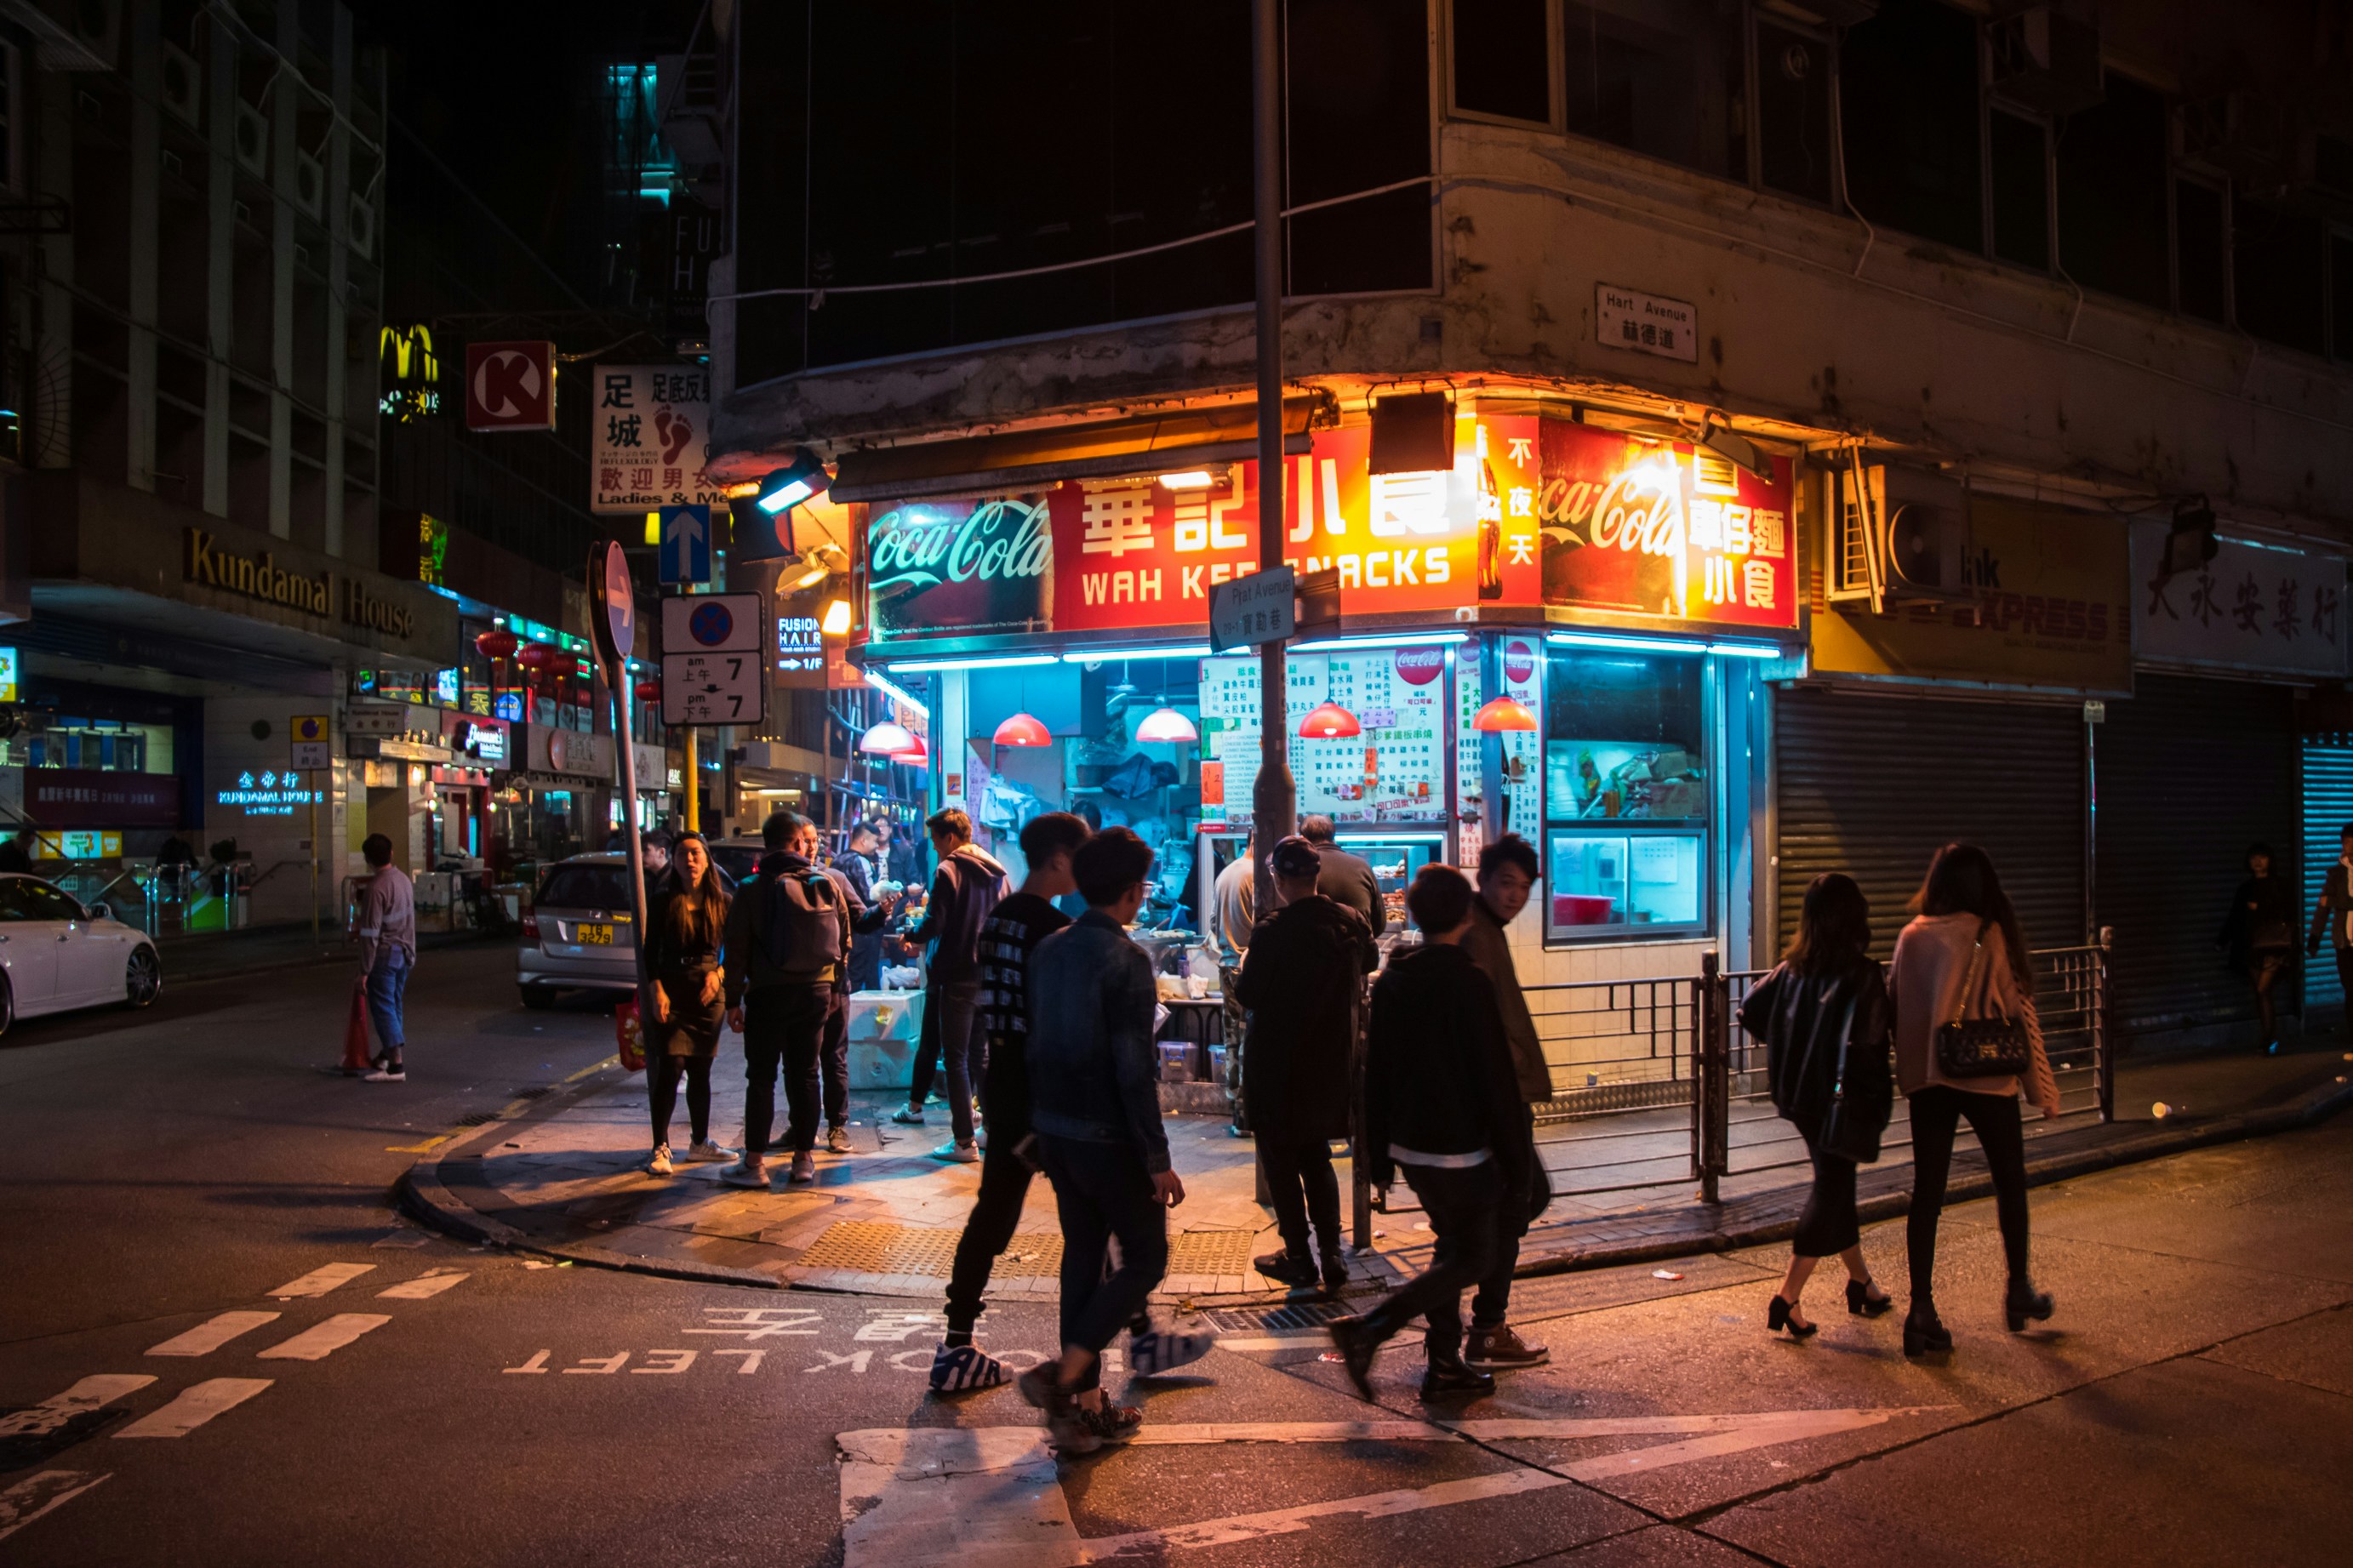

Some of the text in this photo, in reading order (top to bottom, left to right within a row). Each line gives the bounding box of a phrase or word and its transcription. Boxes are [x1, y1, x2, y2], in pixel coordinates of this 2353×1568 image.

[1607, 293, 1687, 322] Hart Avenue
[1623, 320, 1674, 350] 赫德道
[598, 492, 729, 505] Ladies & Me
[1082, 455, 1450, 557] 華記小食
[1508, 437, 1533, 566] 不夜天
[1539, 466, 1676, 559] ca-Cola
[1689, 499, 1785, 558] 車仔麵
[869, 499, 1053, 583] Coca-Cola
[191, 527, 413, 635] Kundamal House
[1082, 568, 1162, 606] WAH
[1255, 579, 1291, 599] Avenue
[1704, 555, 1776, 610] 小食
[779, 618, 820, 632] FUSION
[1953, 588, 2107, 641] EXPRESS
[780, 632, 821, 645] HAIR
[727, 659, 742, 681] 7
[803, 658, 823, 670] 1/F
[1396, 650, 1441, 668] Coca-Cola
[682, 670, 711, 681] 上午
[688, 695, 705, 704] pm
[728, 695, 743, 718] 7
[683, 707, 711, 718] 下午
[1419, 707, 1427, 716] 元
[218, 790, 323, 804] KUNDAMAL HOUE
[580, 932, 611, 944] 3279
[502, 1348, 766, 1374] LEFT
